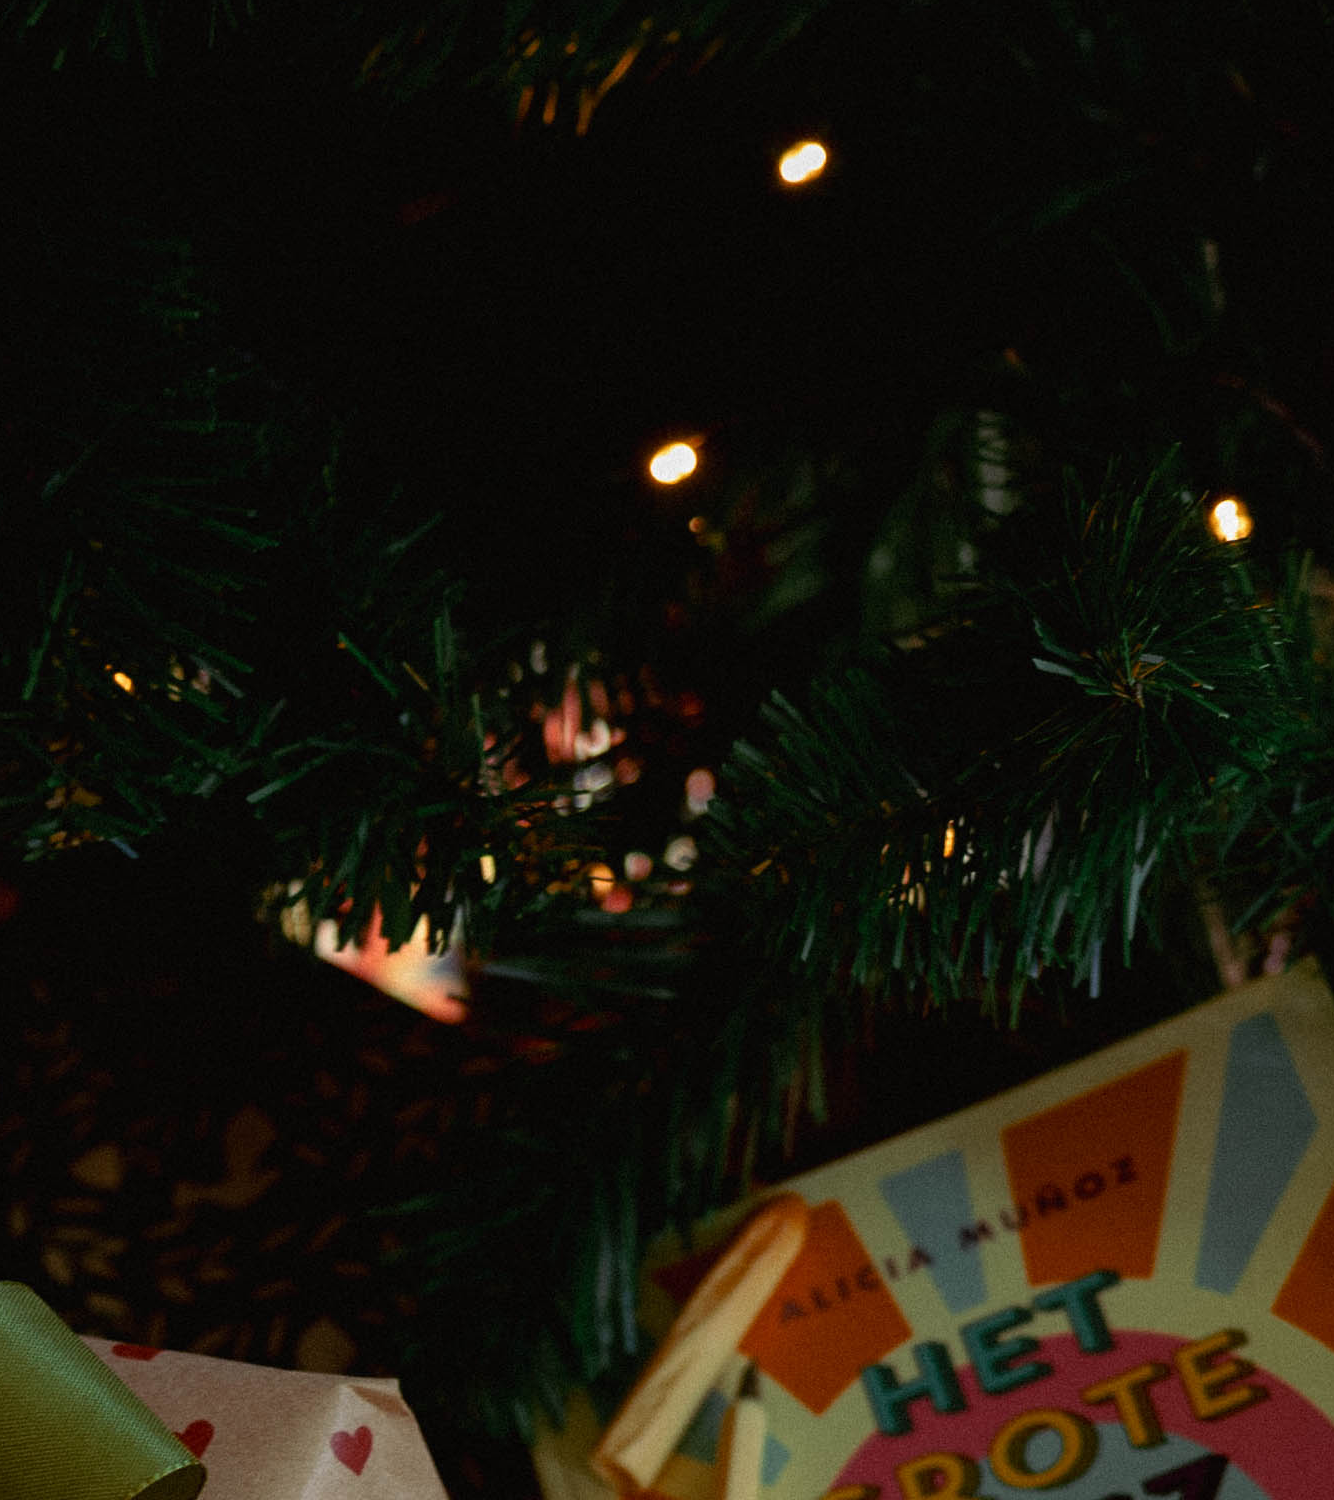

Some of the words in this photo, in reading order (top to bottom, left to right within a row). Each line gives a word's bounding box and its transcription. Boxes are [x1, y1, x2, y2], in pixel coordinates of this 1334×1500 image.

[780, 1245, 933, 1323] ALICIA
[959, 1155, 1137, 1251] MUÑOZ
[860, 1268, 1122, 1436] HET
